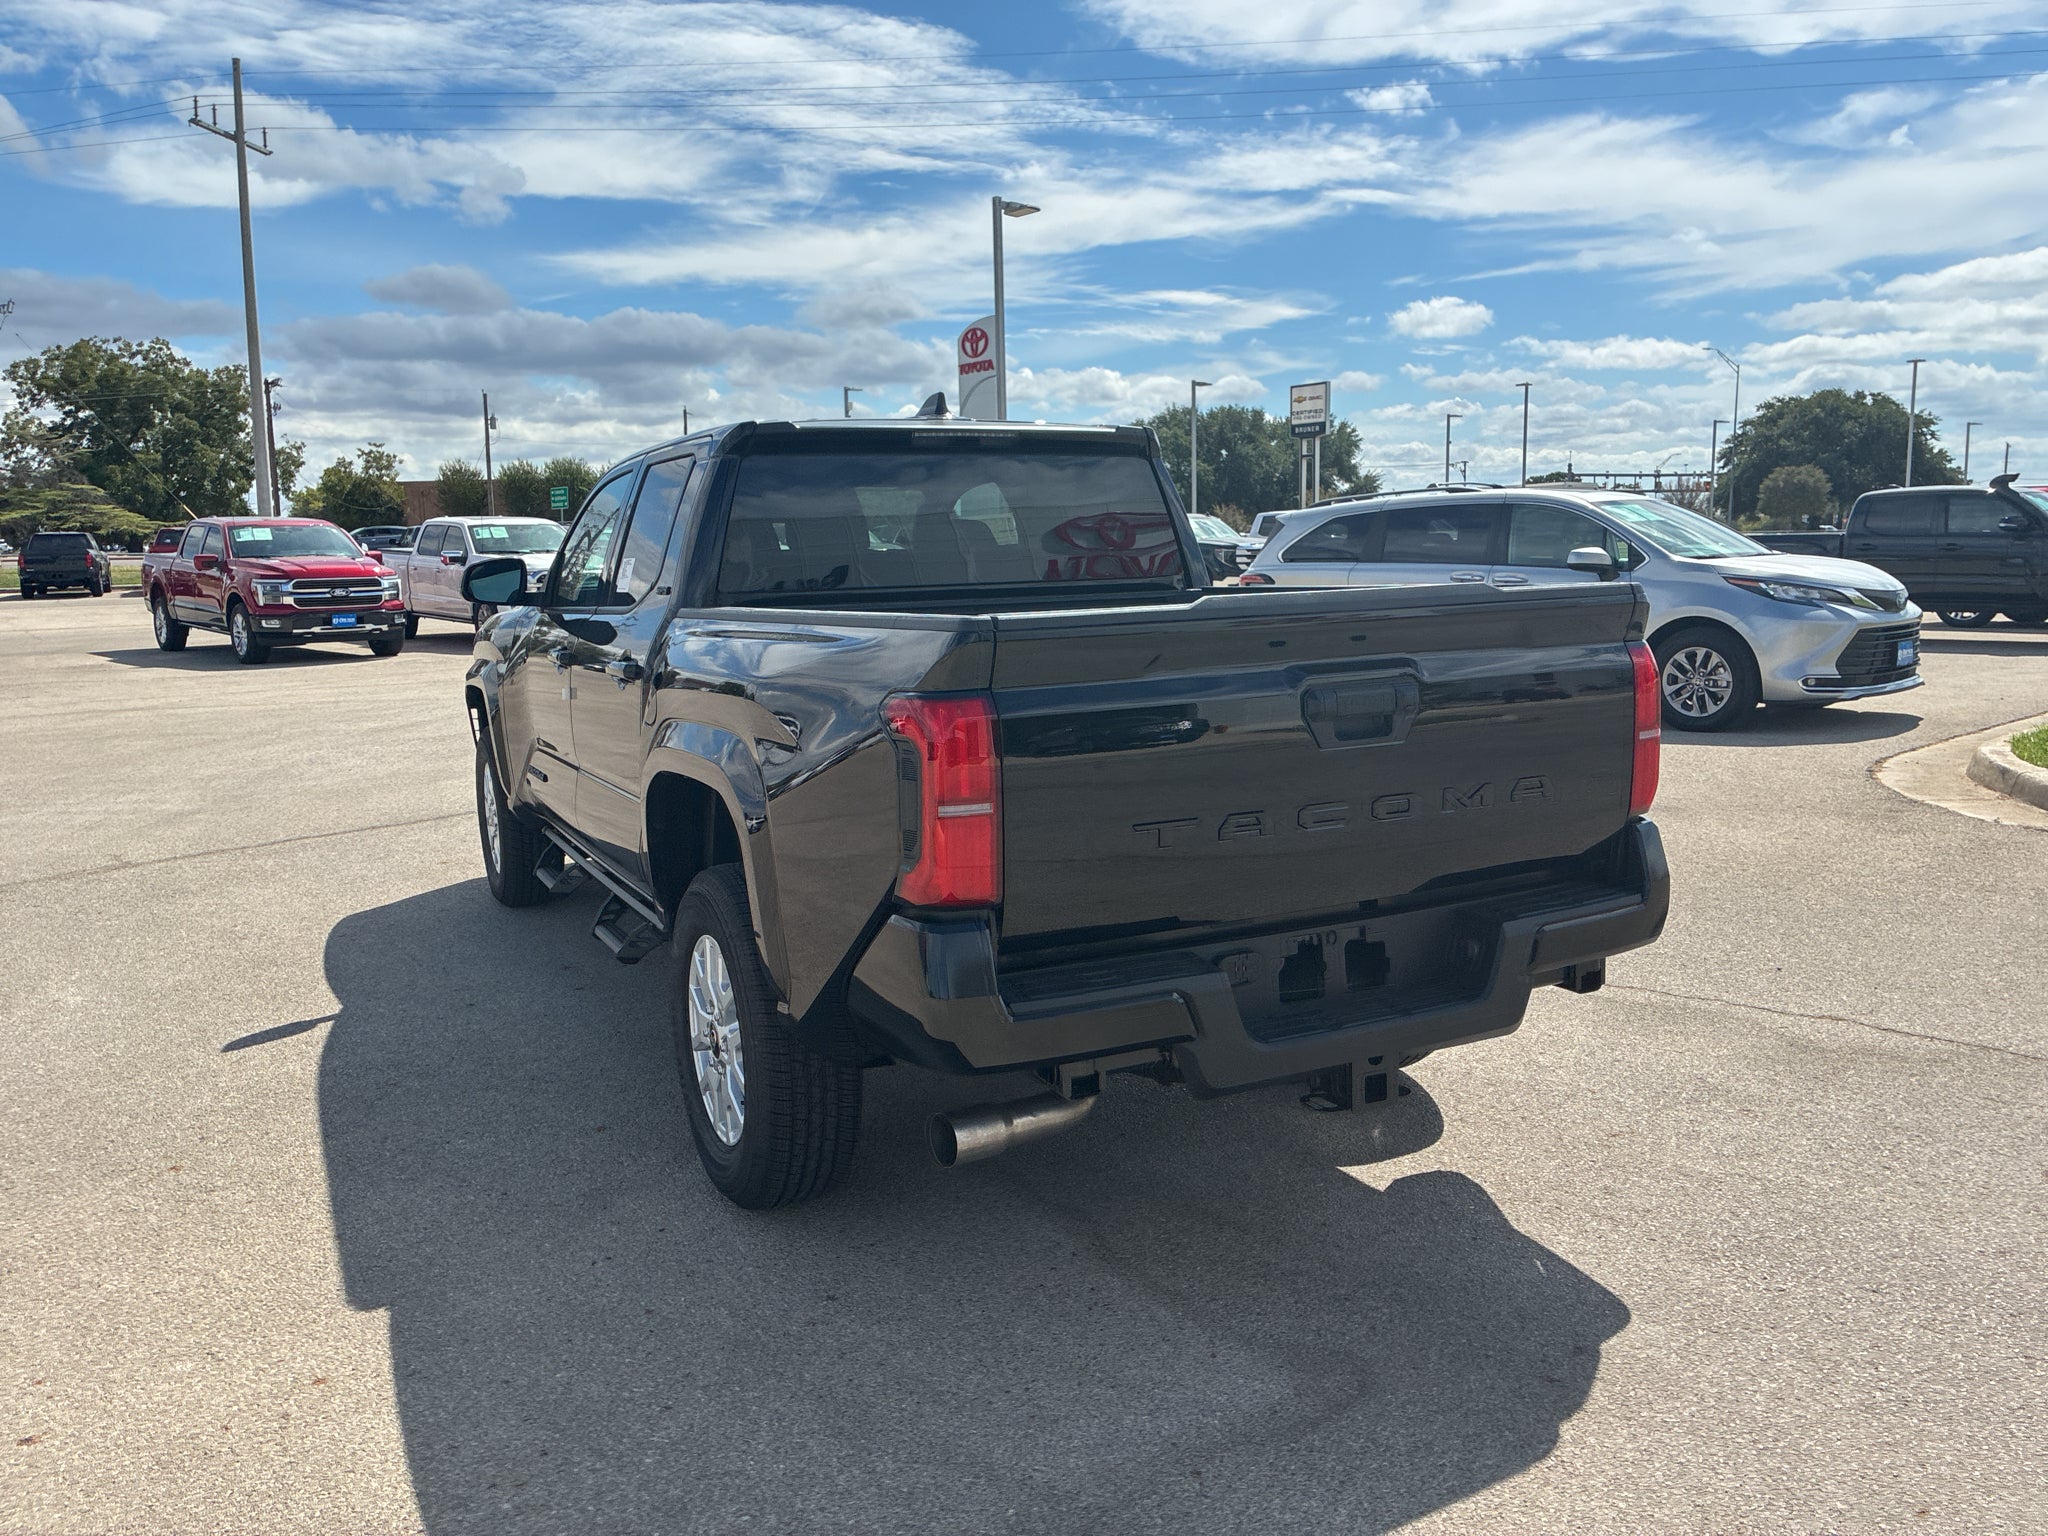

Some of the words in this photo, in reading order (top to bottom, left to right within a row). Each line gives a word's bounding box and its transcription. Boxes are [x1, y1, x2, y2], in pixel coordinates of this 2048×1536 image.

[959, 360, 994, 375] TOYOTA
[1295, 425, 1320, 433] BRUNER
[1132, 775, 1553, 848] TACOMA
